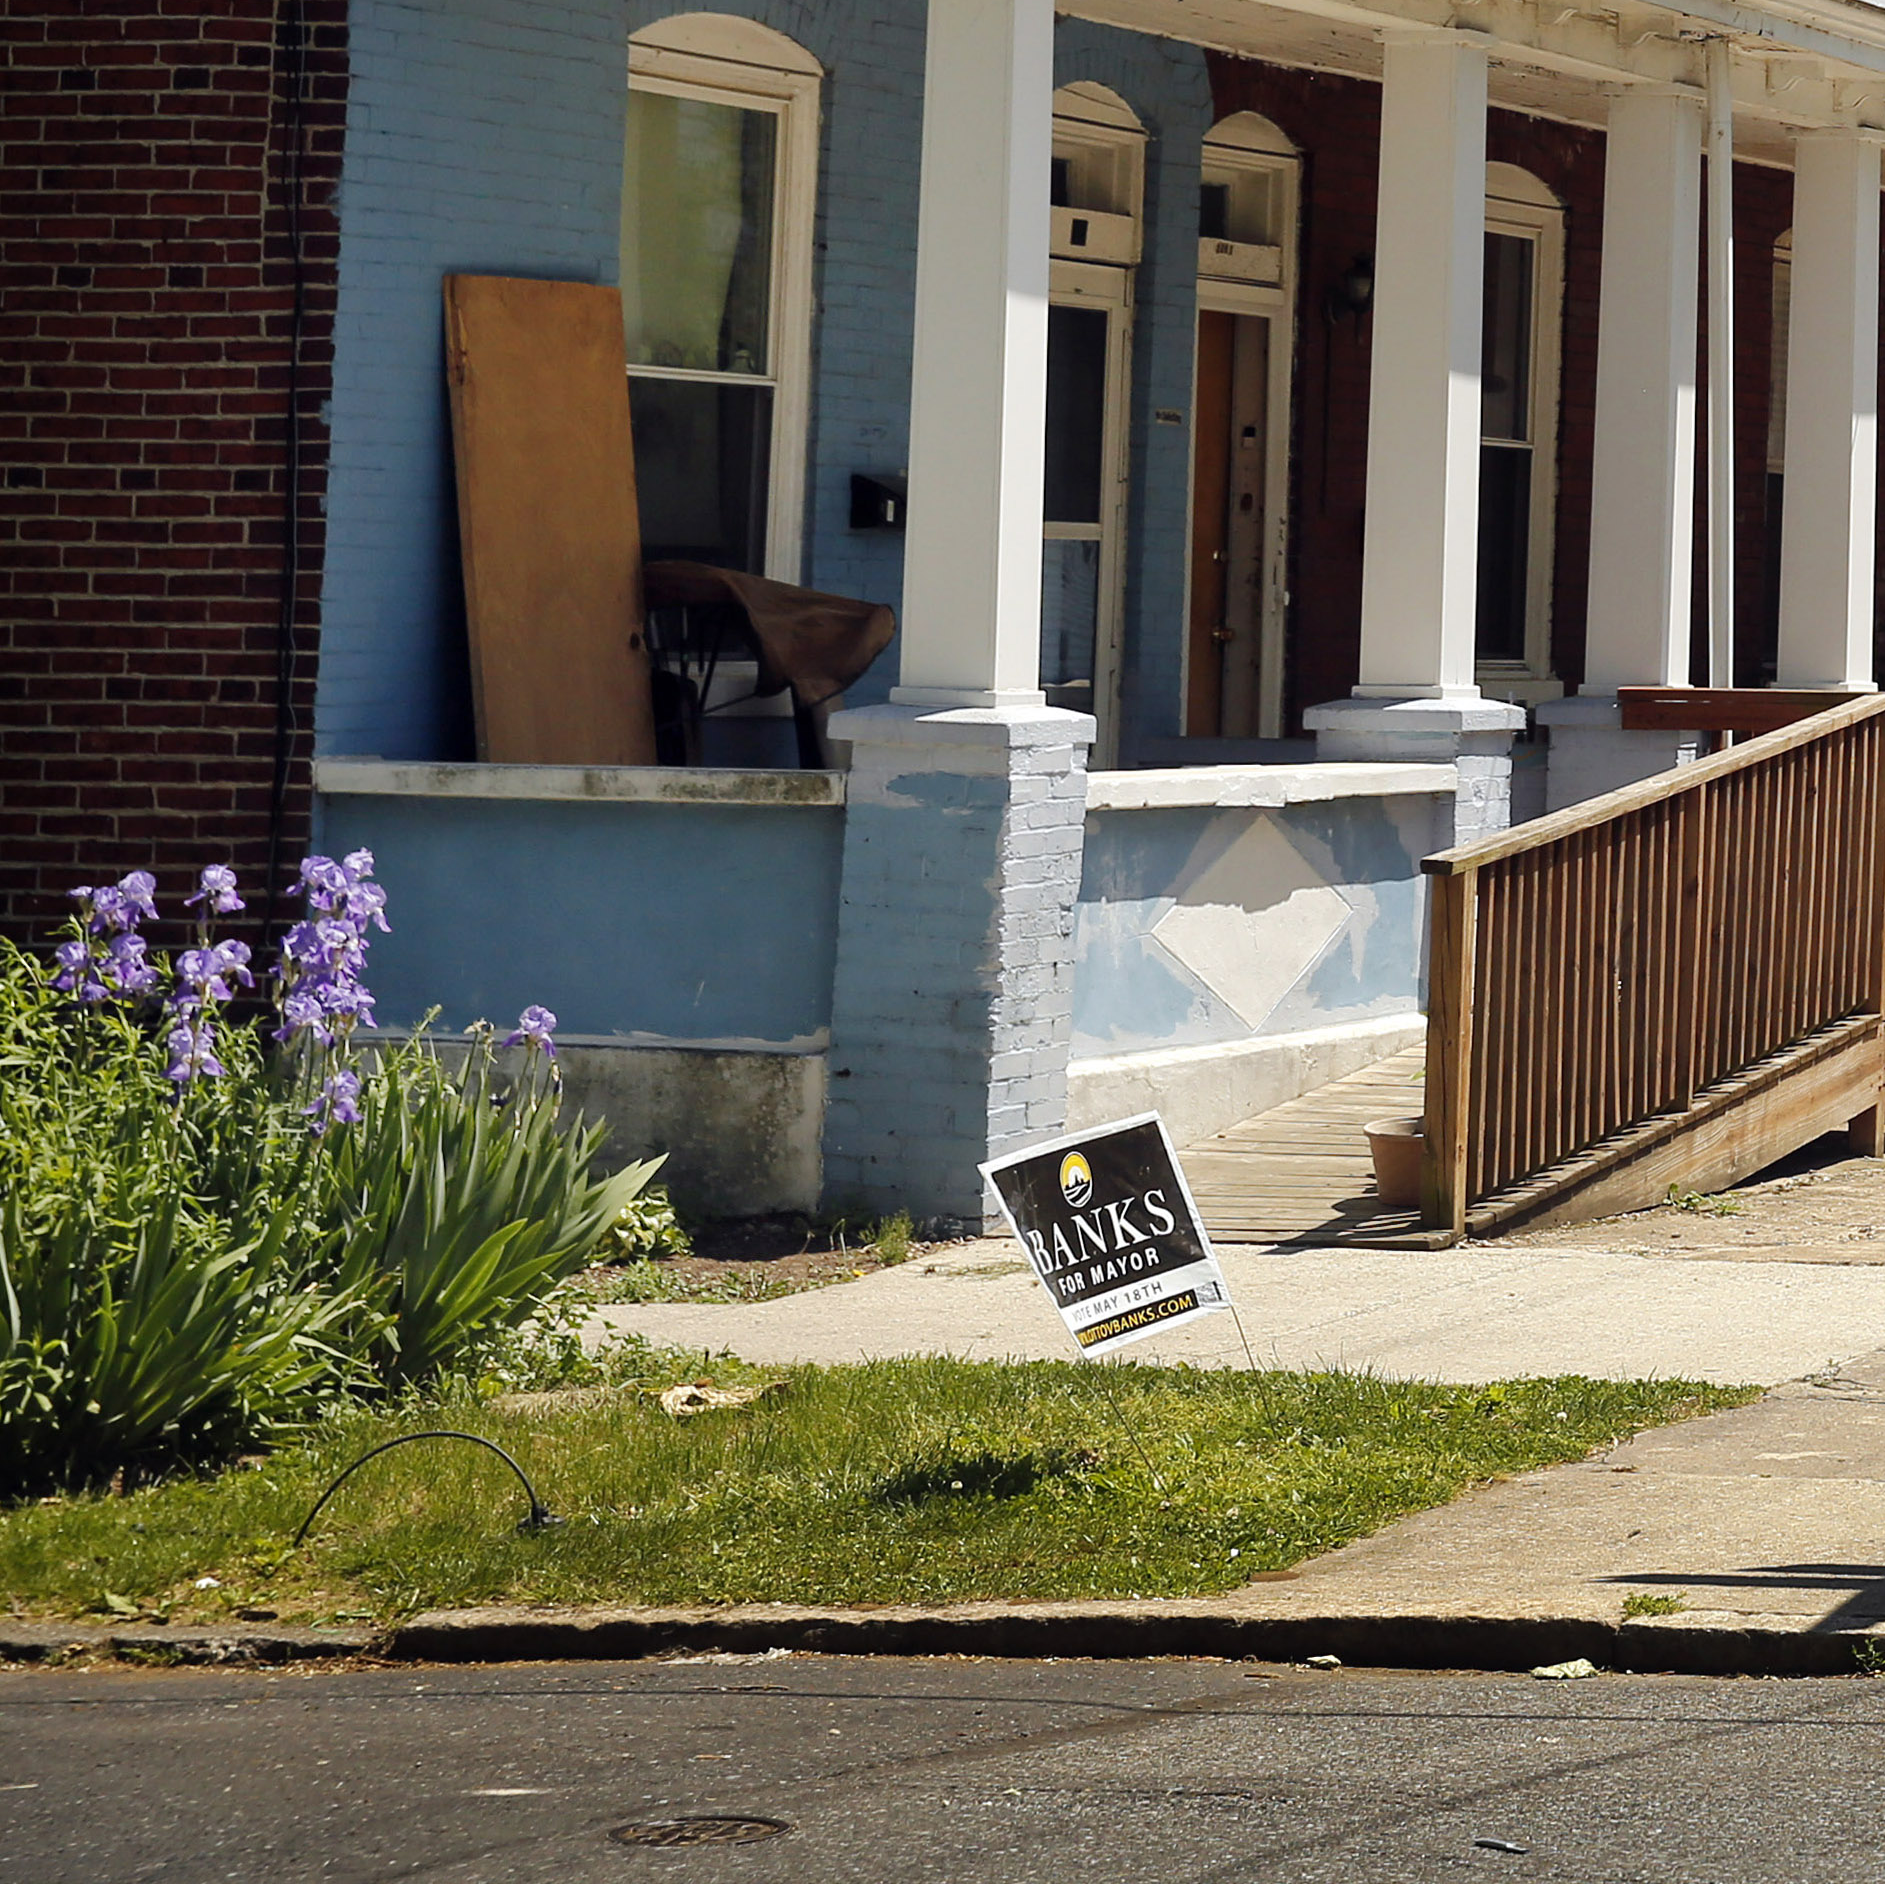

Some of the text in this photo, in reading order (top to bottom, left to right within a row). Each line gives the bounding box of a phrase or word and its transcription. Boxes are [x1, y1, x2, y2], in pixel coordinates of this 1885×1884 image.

[1027, 1188, 1176, 1275] BANKS
[1057, 1247, 1160, 1297] FOR MAYOR
[1093, 1296, 1119, 1312] MAY
[1125, 1281, 1163, 1304] 18TH
